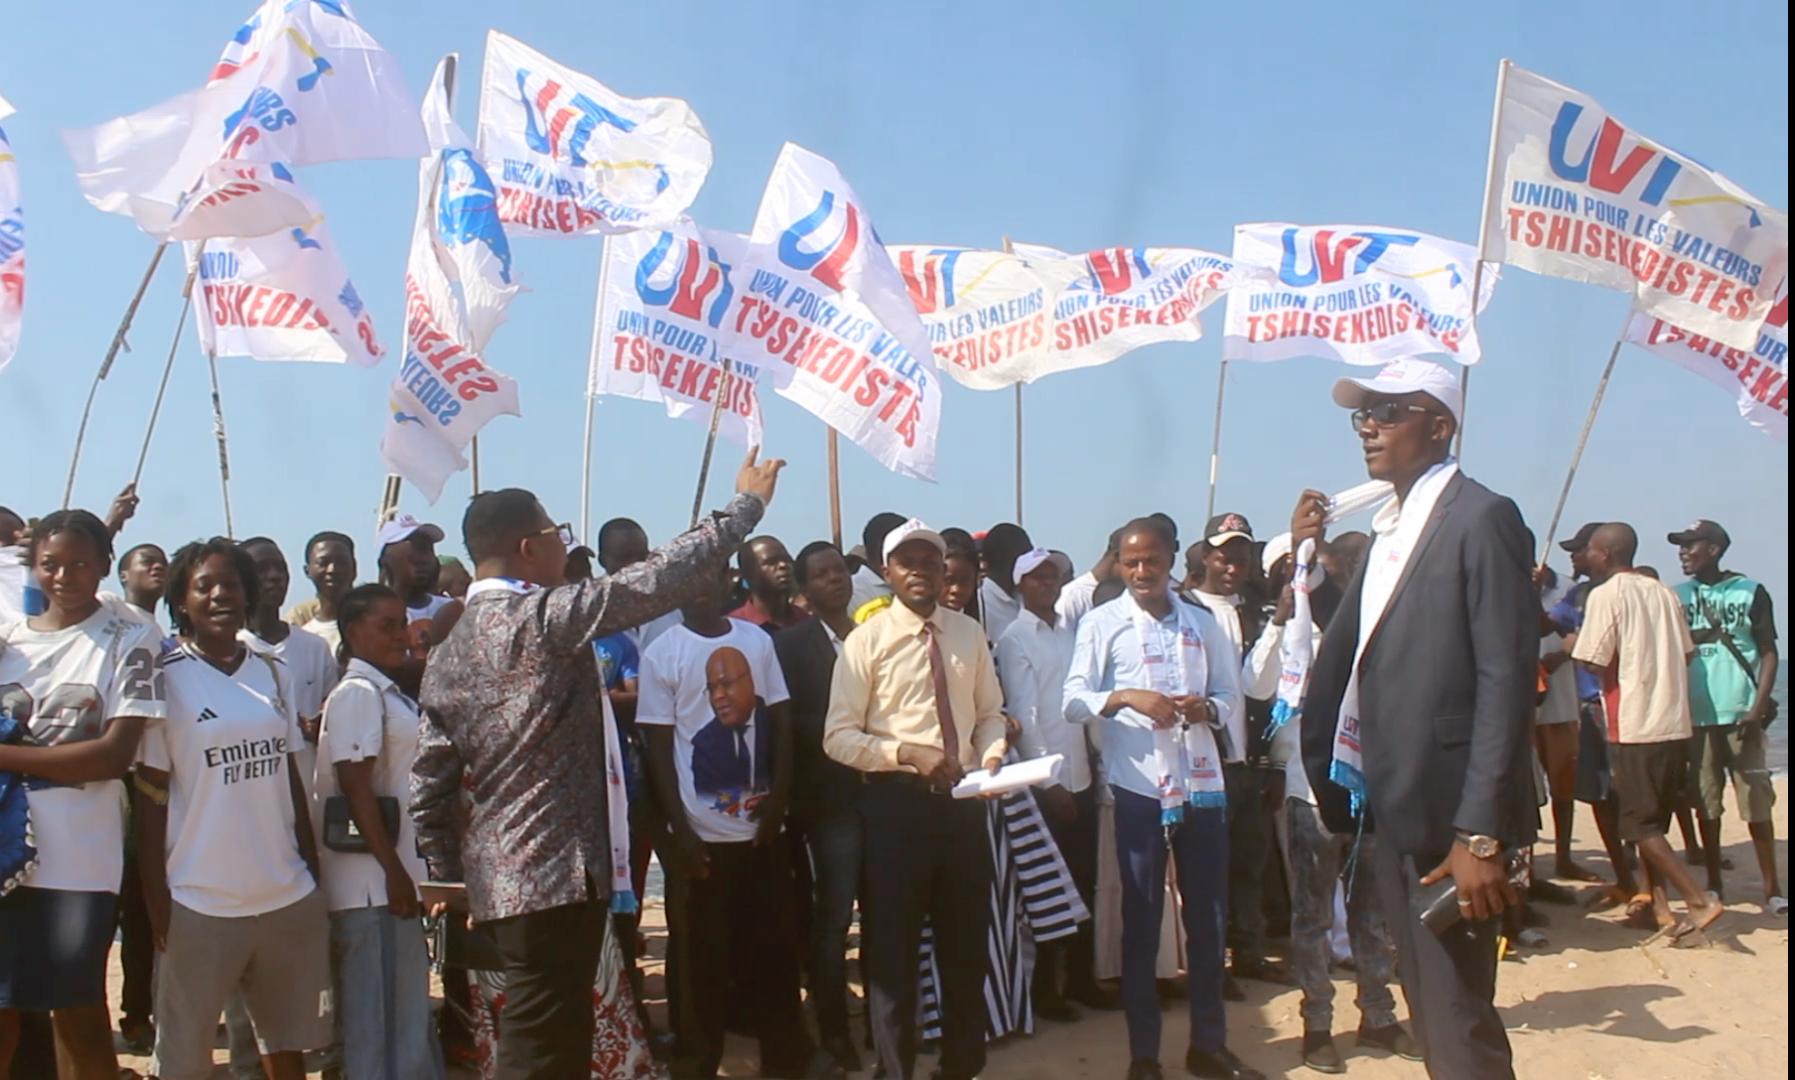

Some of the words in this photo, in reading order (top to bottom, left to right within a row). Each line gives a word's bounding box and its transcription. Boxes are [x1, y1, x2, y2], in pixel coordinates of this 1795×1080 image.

[778, 189, 858, 292] UV
[1279, 228, 1420, 288] UVT
[1512, 181, 1579, 214] UNION
[1584, 197, 1630, 234] POUR
[1634, 214, 1669, 246] LES
[1672, 229, 1762, 287] VALEURS
[901, 249, 960, 314] VT
[1507, 208, 1755, 322] TSHISEKEDISTES
[784, 286, 841, 328] POUR
[834, 314, 874, 343] LES
[949, 313, 975, 340] LES
[976, 287, 1044, 330] VALEURS
[1054, 294, 1089, 321] ION
[1151, 279, 1174, 305] LES
[1250, 291, 1307, 313] UNION
[1313, 293, 1357, 312] POUR
[1358, 282, 1381, 304] LES
[652, 319, 707, 357] POUR
